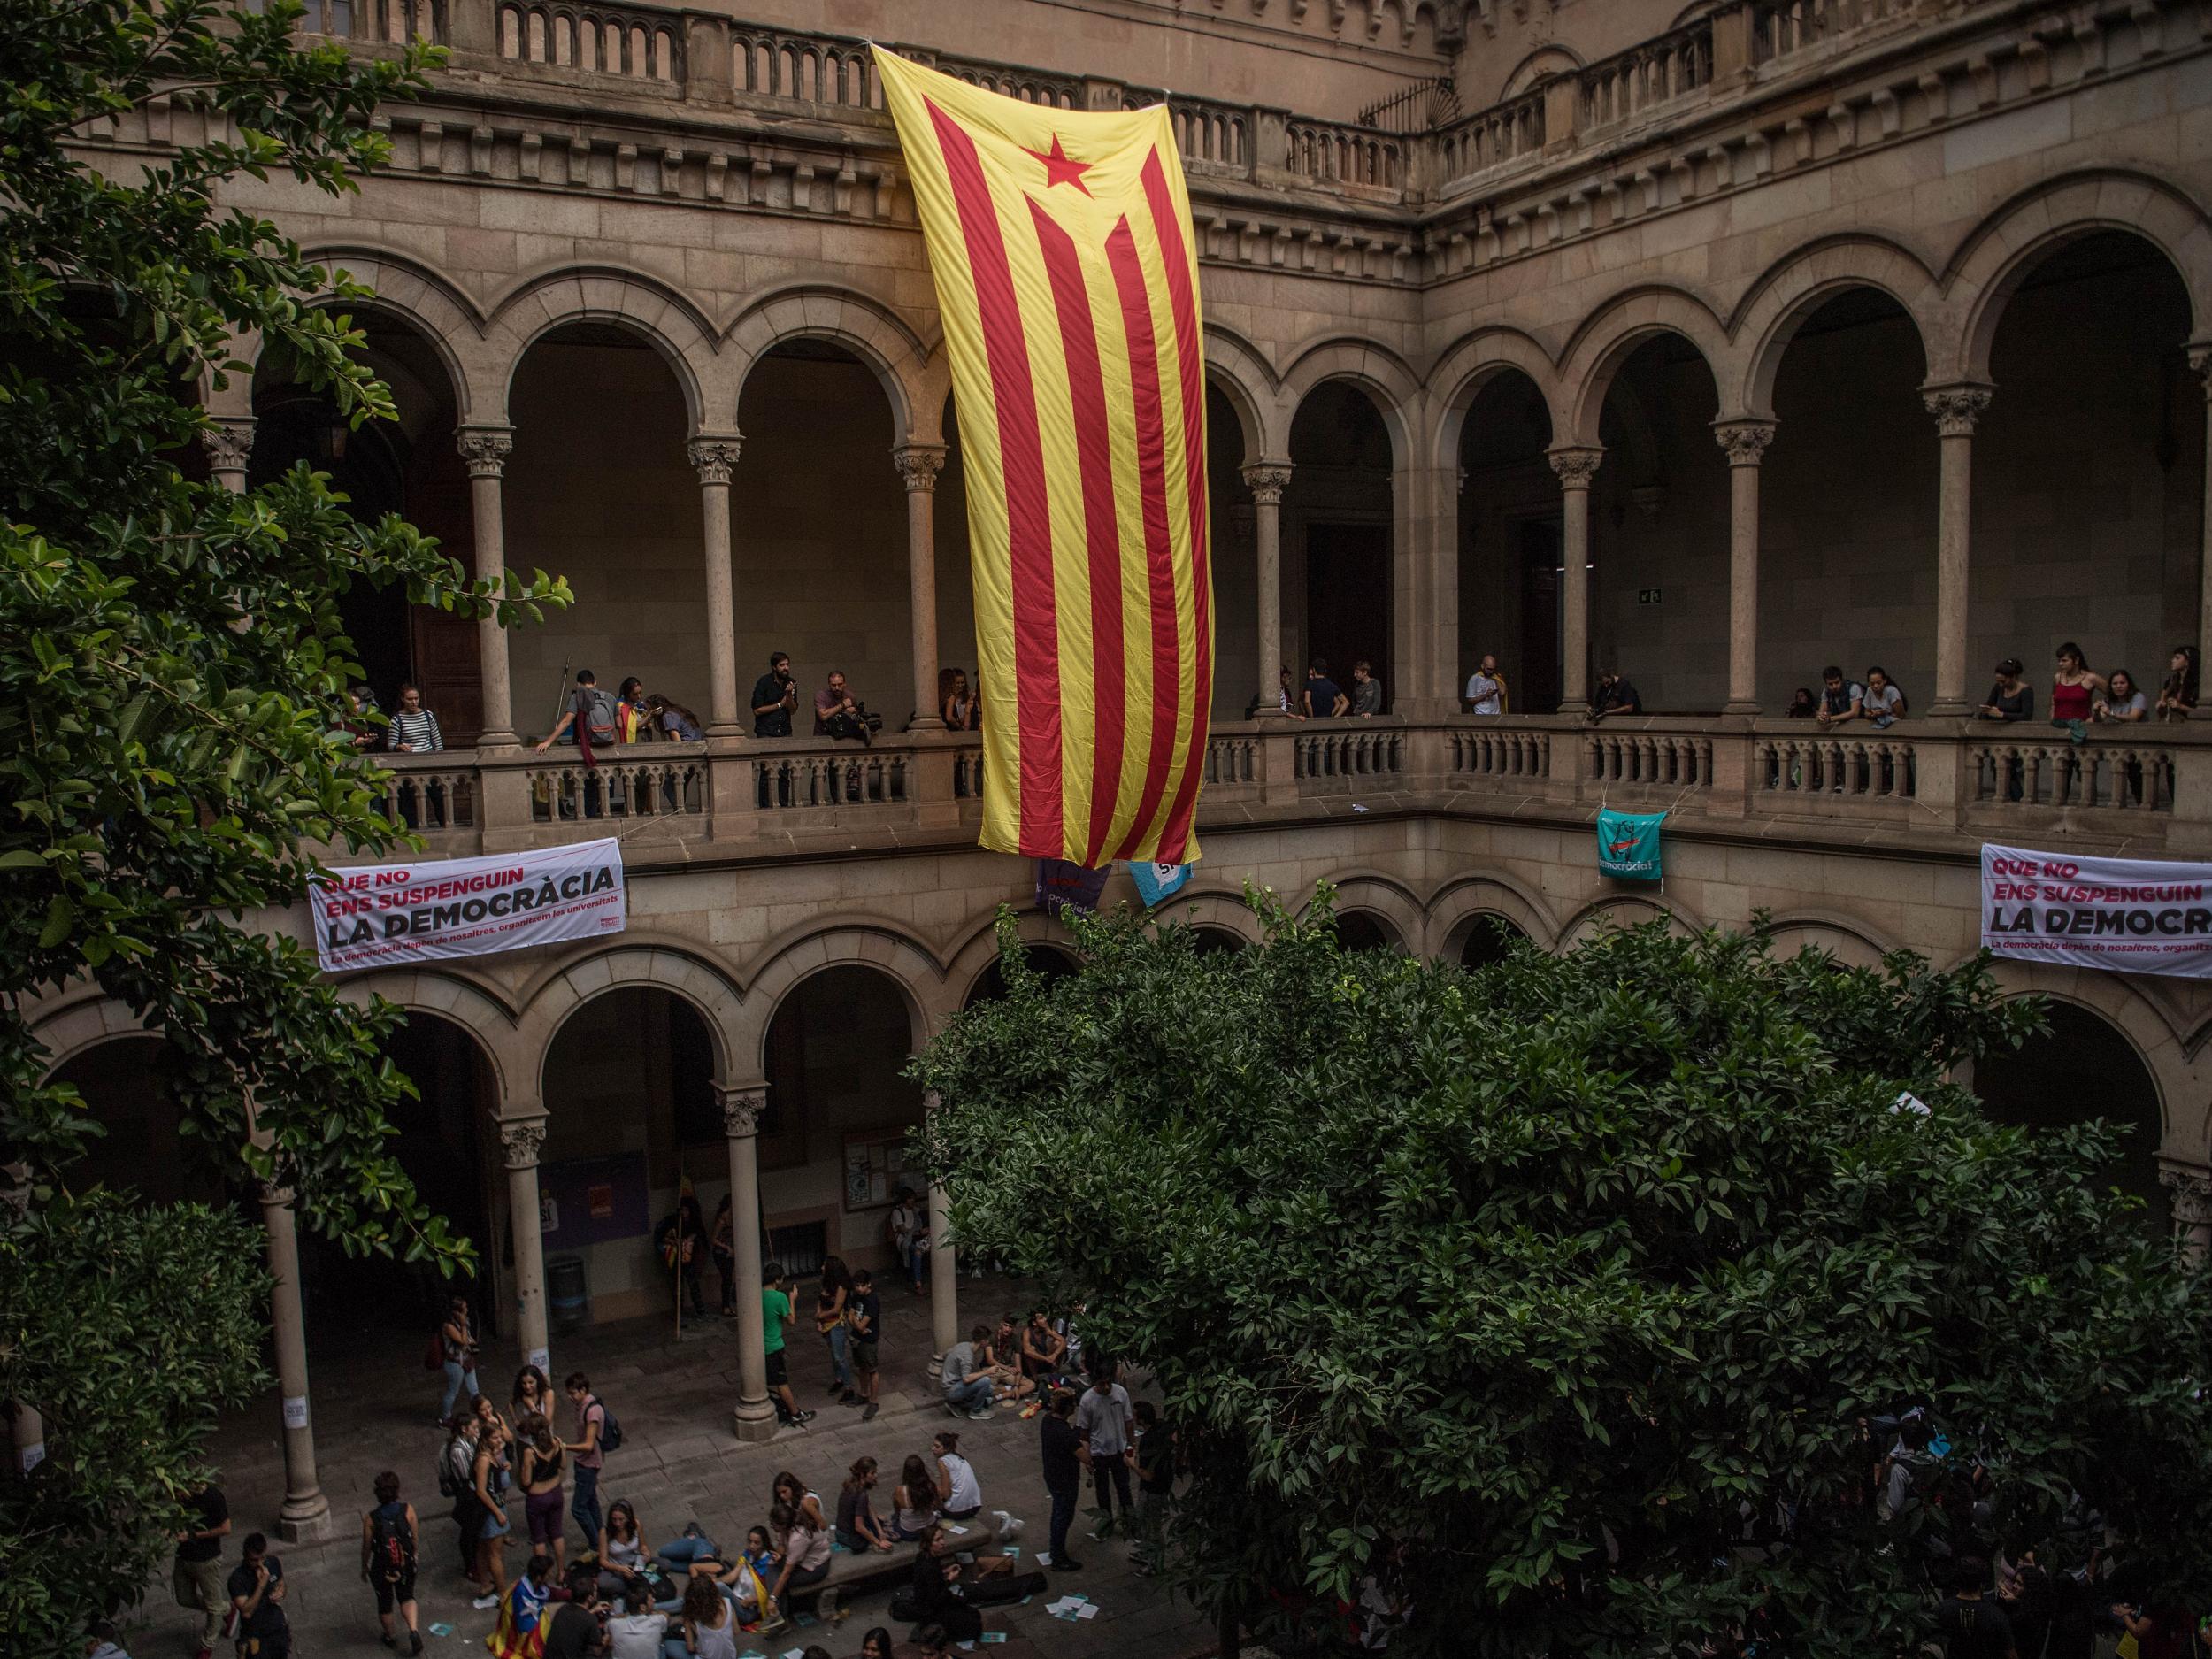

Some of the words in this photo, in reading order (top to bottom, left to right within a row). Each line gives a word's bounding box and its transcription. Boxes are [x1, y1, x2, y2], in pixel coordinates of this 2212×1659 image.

[1993, 858, 2039, 877] QUE
[2044, 862, 2079, 879] NO
[321, 874, 370, 895] QUE
[376, 871, 411, 887] NO
[326, 897, 373, 918] ENS
[379, 867, 524, 910] SUSPENGUIN
[1993, 883, 2039, 901] ENS
[2043, 884, 2202, 903] SUSPENGUIN
[329, 918, 375, 949] LA
[384, 866, 614, 939] DEMOCRÀCIA
[1991, 906, 2035, 933] LA
[2045, 907, 2212, 935] DEMOCR
[331, 956, 343, 964] La
[344, 944, 402, 963] democràcia
[435, 936, 448, 946] de
[449, 926, 497, 943] nosaltres,
[499, 912, 551, 932] organitzem
[552, 906, 565, 918] les
[566, 895, 619, 914] universitats
[1991, 940, 2001, 949] La
[2002, 940, 2060, 949] democràcia
[2093, 941, 2105, 951] de
[2108, 941, 2160, 953] nosaltres,
